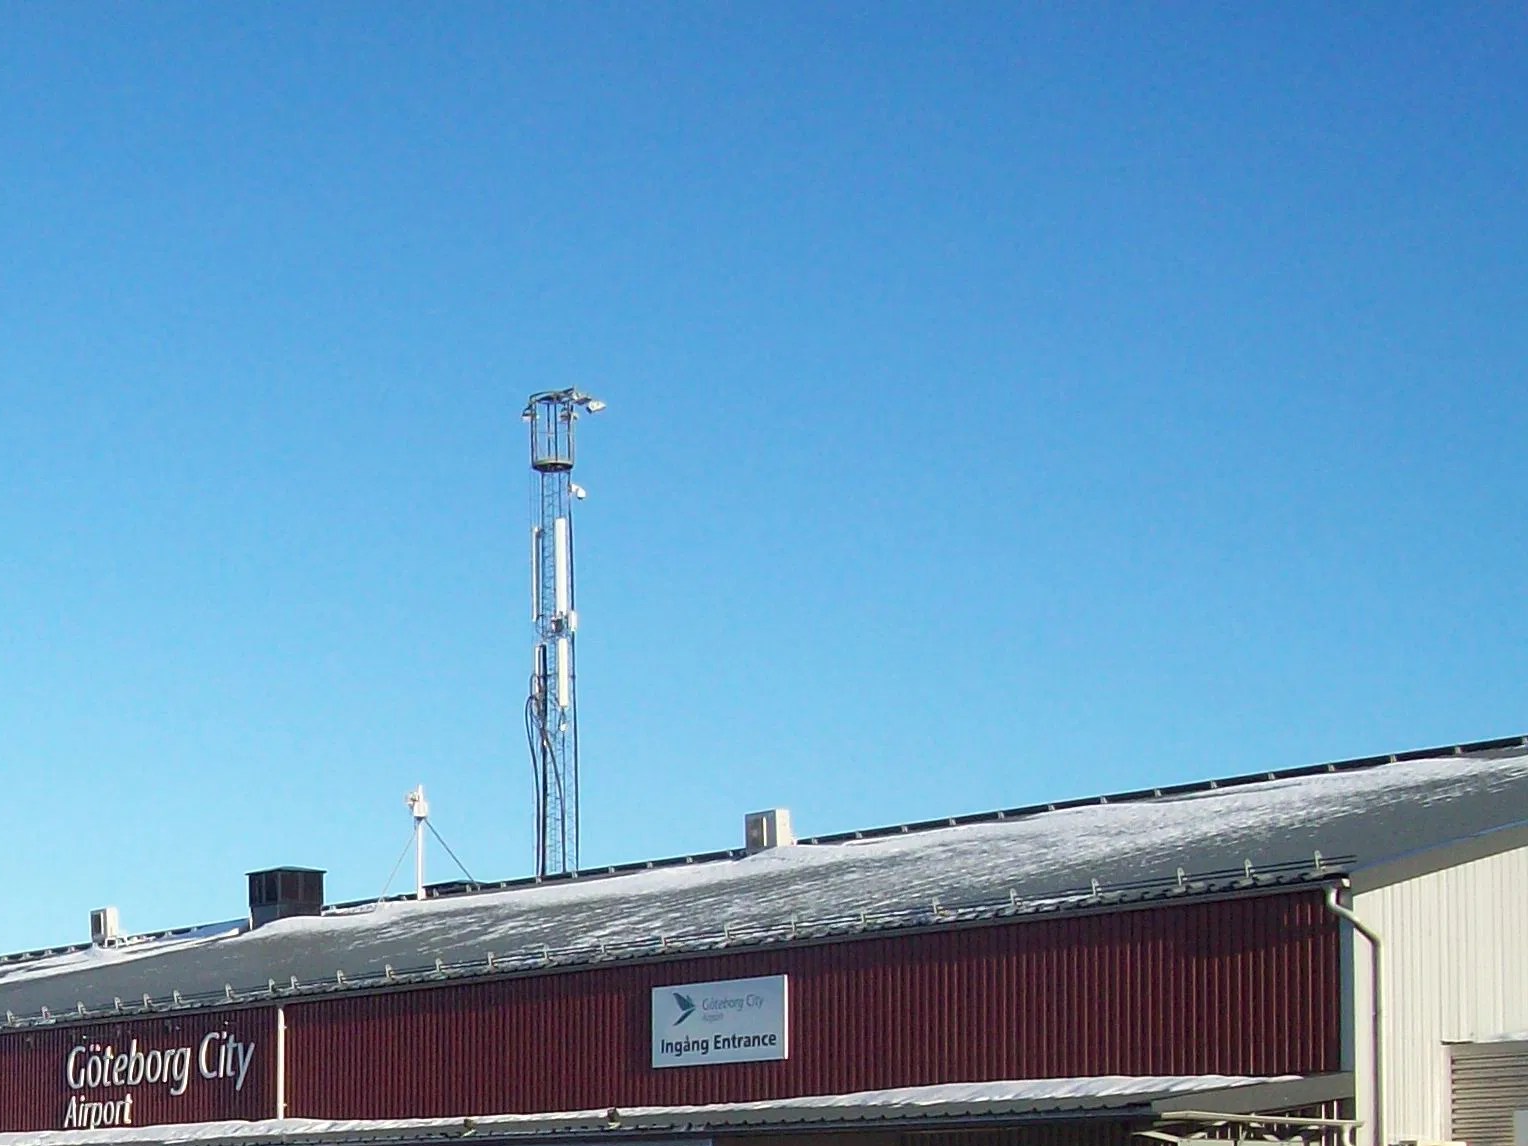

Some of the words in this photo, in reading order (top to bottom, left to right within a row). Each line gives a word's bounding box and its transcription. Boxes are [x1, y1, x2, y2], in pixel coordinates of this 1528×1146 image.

[66, 1039, 191, 1095] Göteborg
[198, 1031, 255, 1091] City
[661, 1036, 709, 1056] Ingång
[713, 1033, 776, 1050] Entrance
[64, 1093, 133, 1130] Airport
